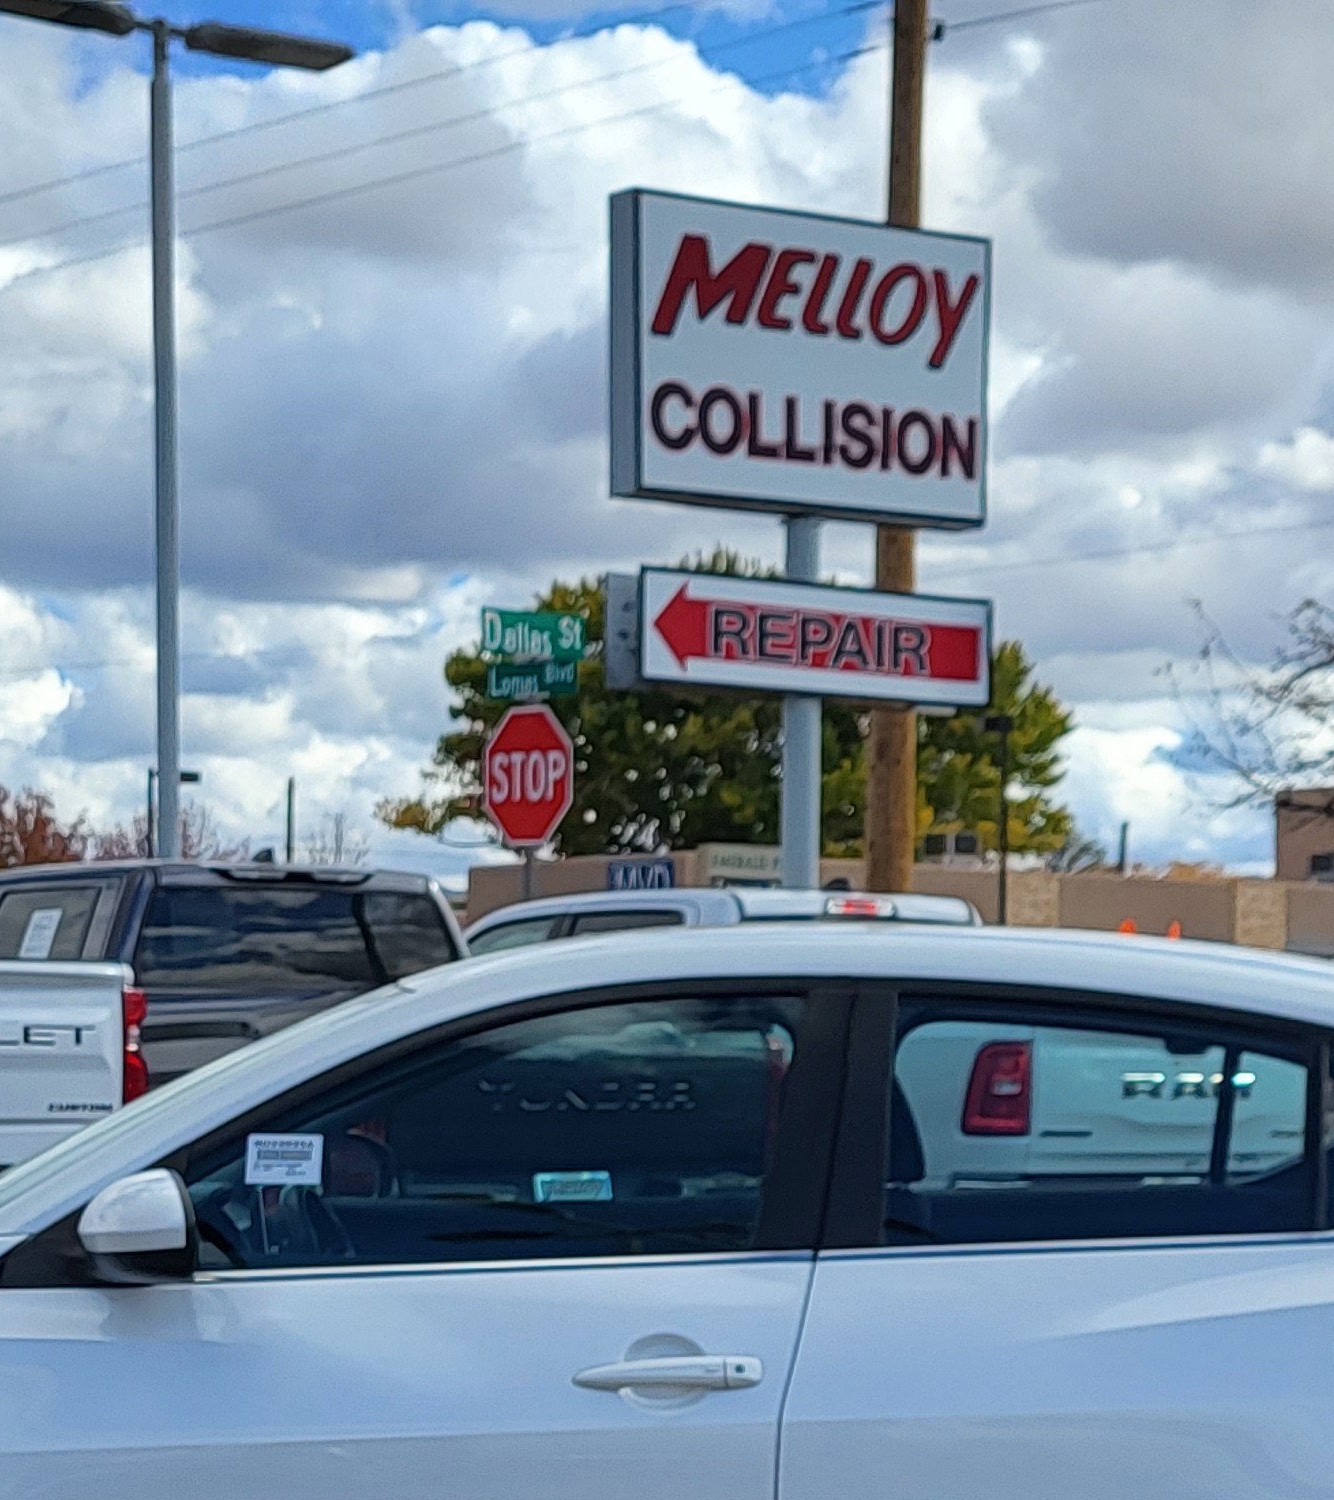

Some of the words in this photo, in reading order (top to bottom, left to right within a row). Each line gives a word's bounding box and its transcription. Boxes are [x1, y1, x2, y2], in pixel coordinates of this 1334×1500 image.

[651, 383, 977, 480] COLLISION
[484, 611, 552, 657] Dallas
[558, 615, 582, 650] St
[709, 602, 931, 676] REPAIR
[489, 664, 538, 697] Lomas
[545, 661, 574, 684] Blvd
[491, 749, 566, 804] STOP
